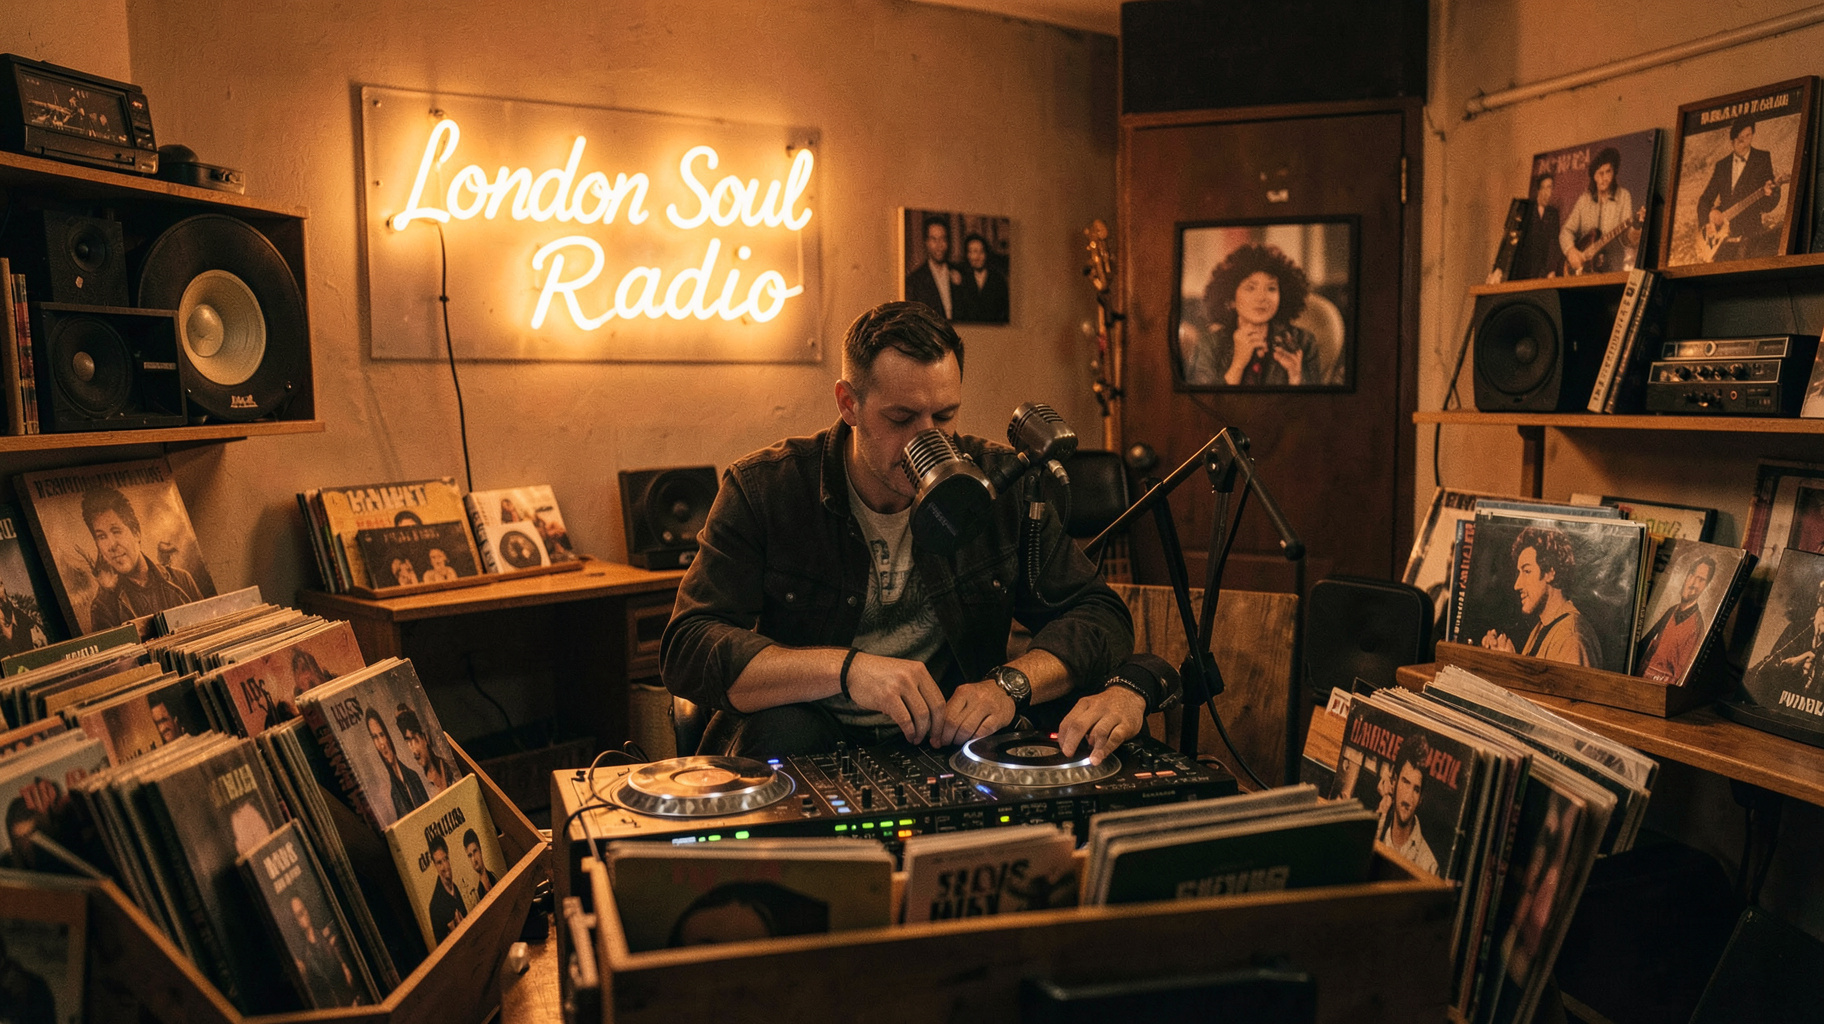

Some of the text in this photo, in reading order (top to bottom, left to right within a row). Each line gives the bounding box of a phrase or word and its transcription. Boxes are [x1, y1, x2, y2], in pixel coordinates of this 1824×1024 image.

[393, 118, 814, 232] London Soul
[531, 235, 804, 331] Radio
